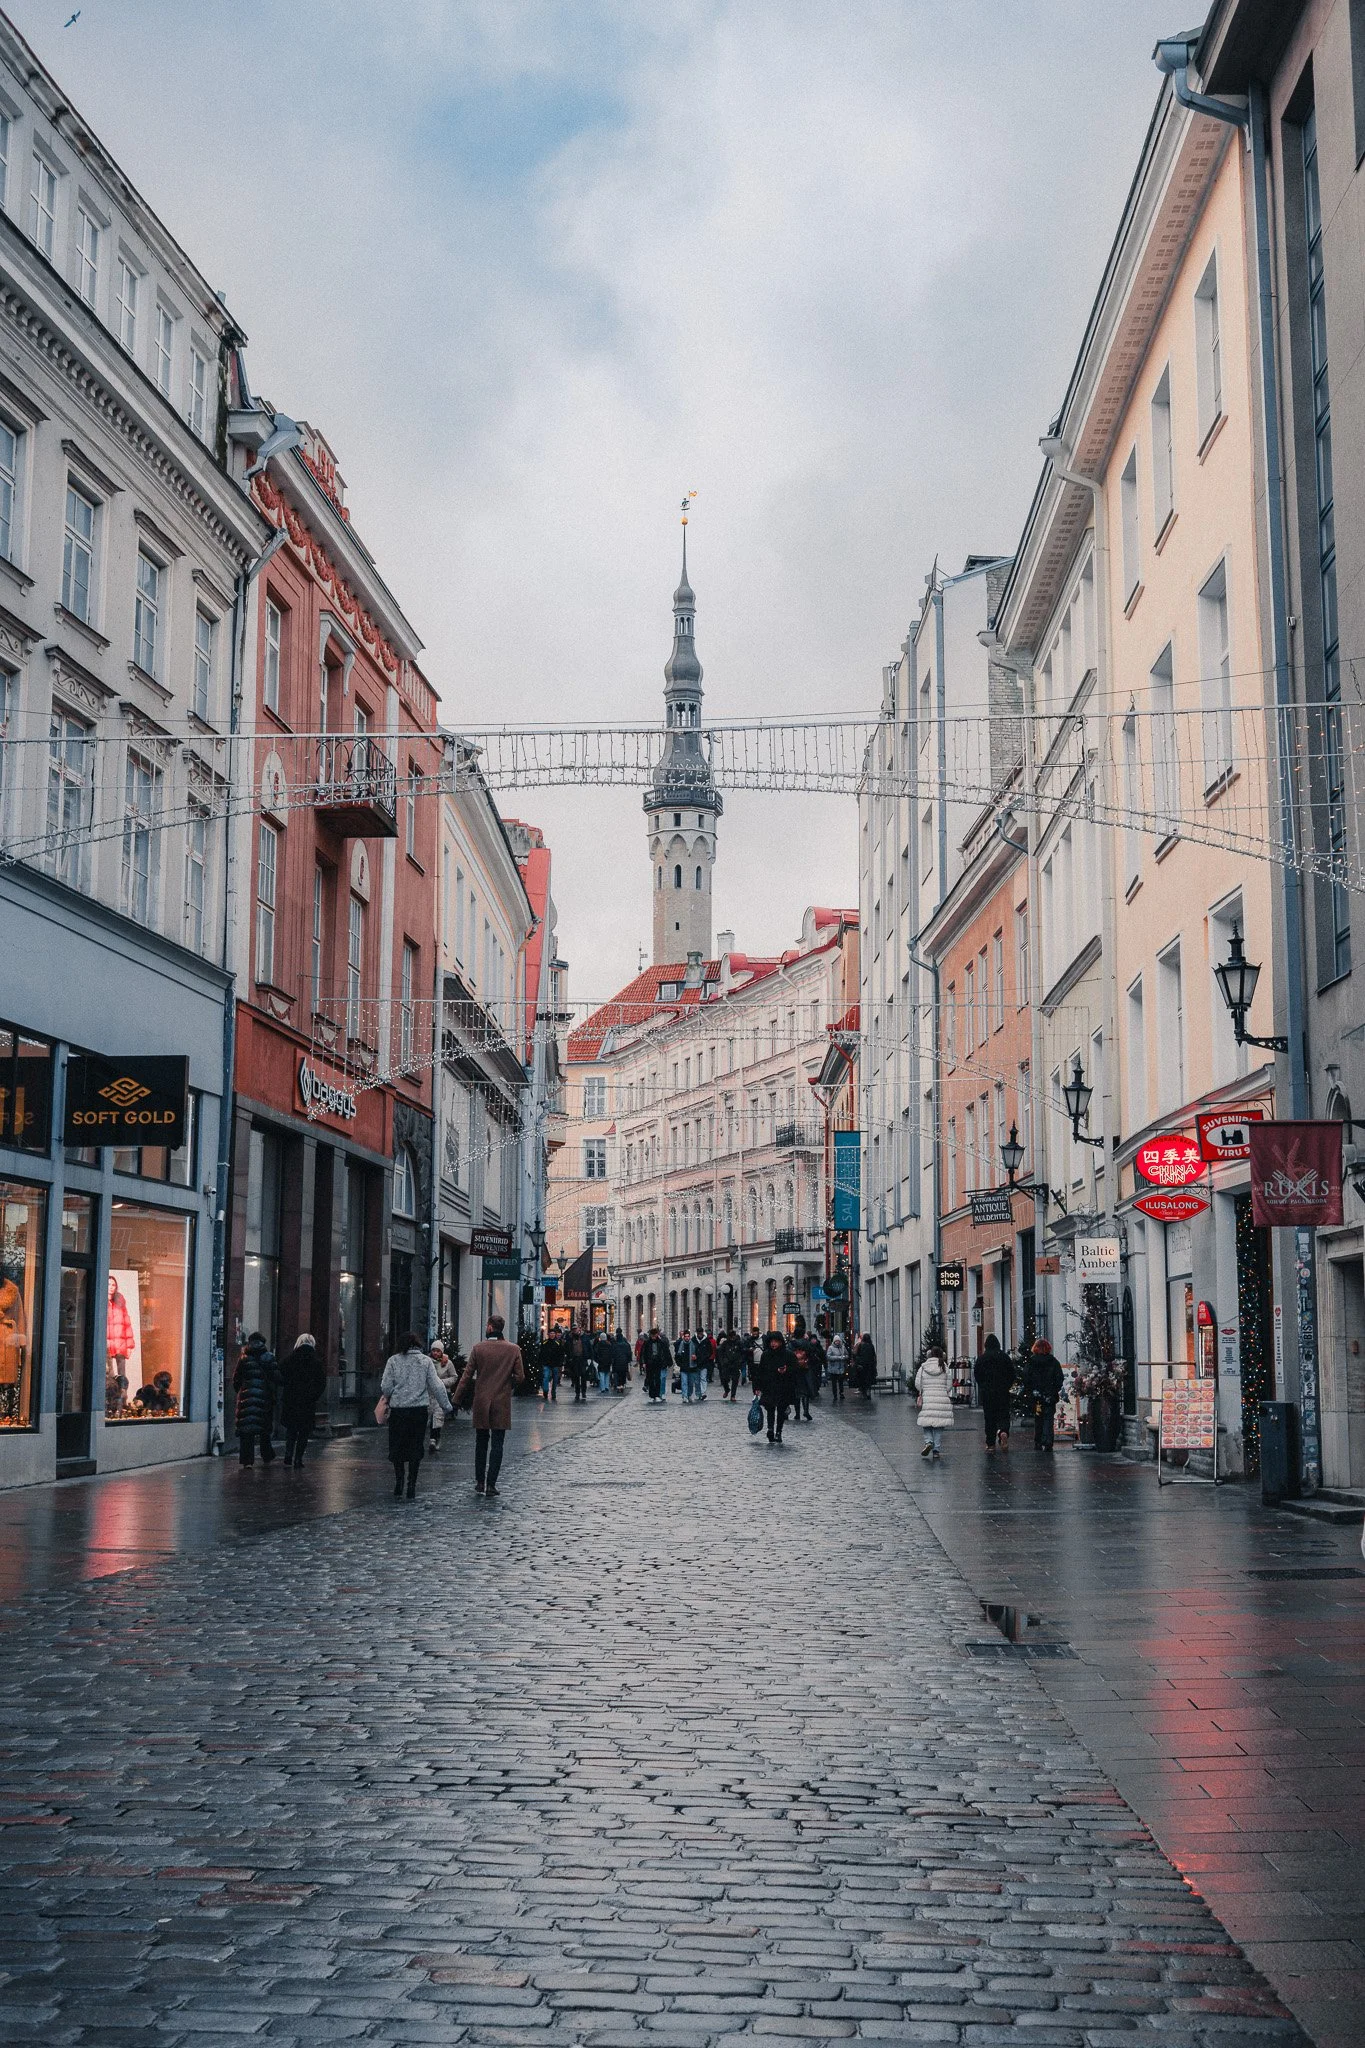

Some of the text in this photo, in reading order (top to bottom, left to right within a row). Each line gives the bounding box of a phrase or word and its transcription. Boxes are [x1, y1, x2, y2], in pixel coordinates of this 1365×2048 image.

[72, 1110, 176, 1125] SOFT GOLD
[1143, 1148, 1200, 1164] 四季美
[1217, 1148, 1242, 1157] VIRU
[1148, 1164, 1196, 1176] CHINA
[1159, 1173, 1186, 1184] INN
[974, 1202, 1007, 1214] ANTIQUE
[474, 1234, 509, 1245] SUVENIIRID
[473, 1243, 508, 1253] SOUVENIRS
[1081, 1245, 1115, 1256] Baltic
[1079, 1258, 1118, 1268] Amber
[940, 1278, 960, 1287] shop
